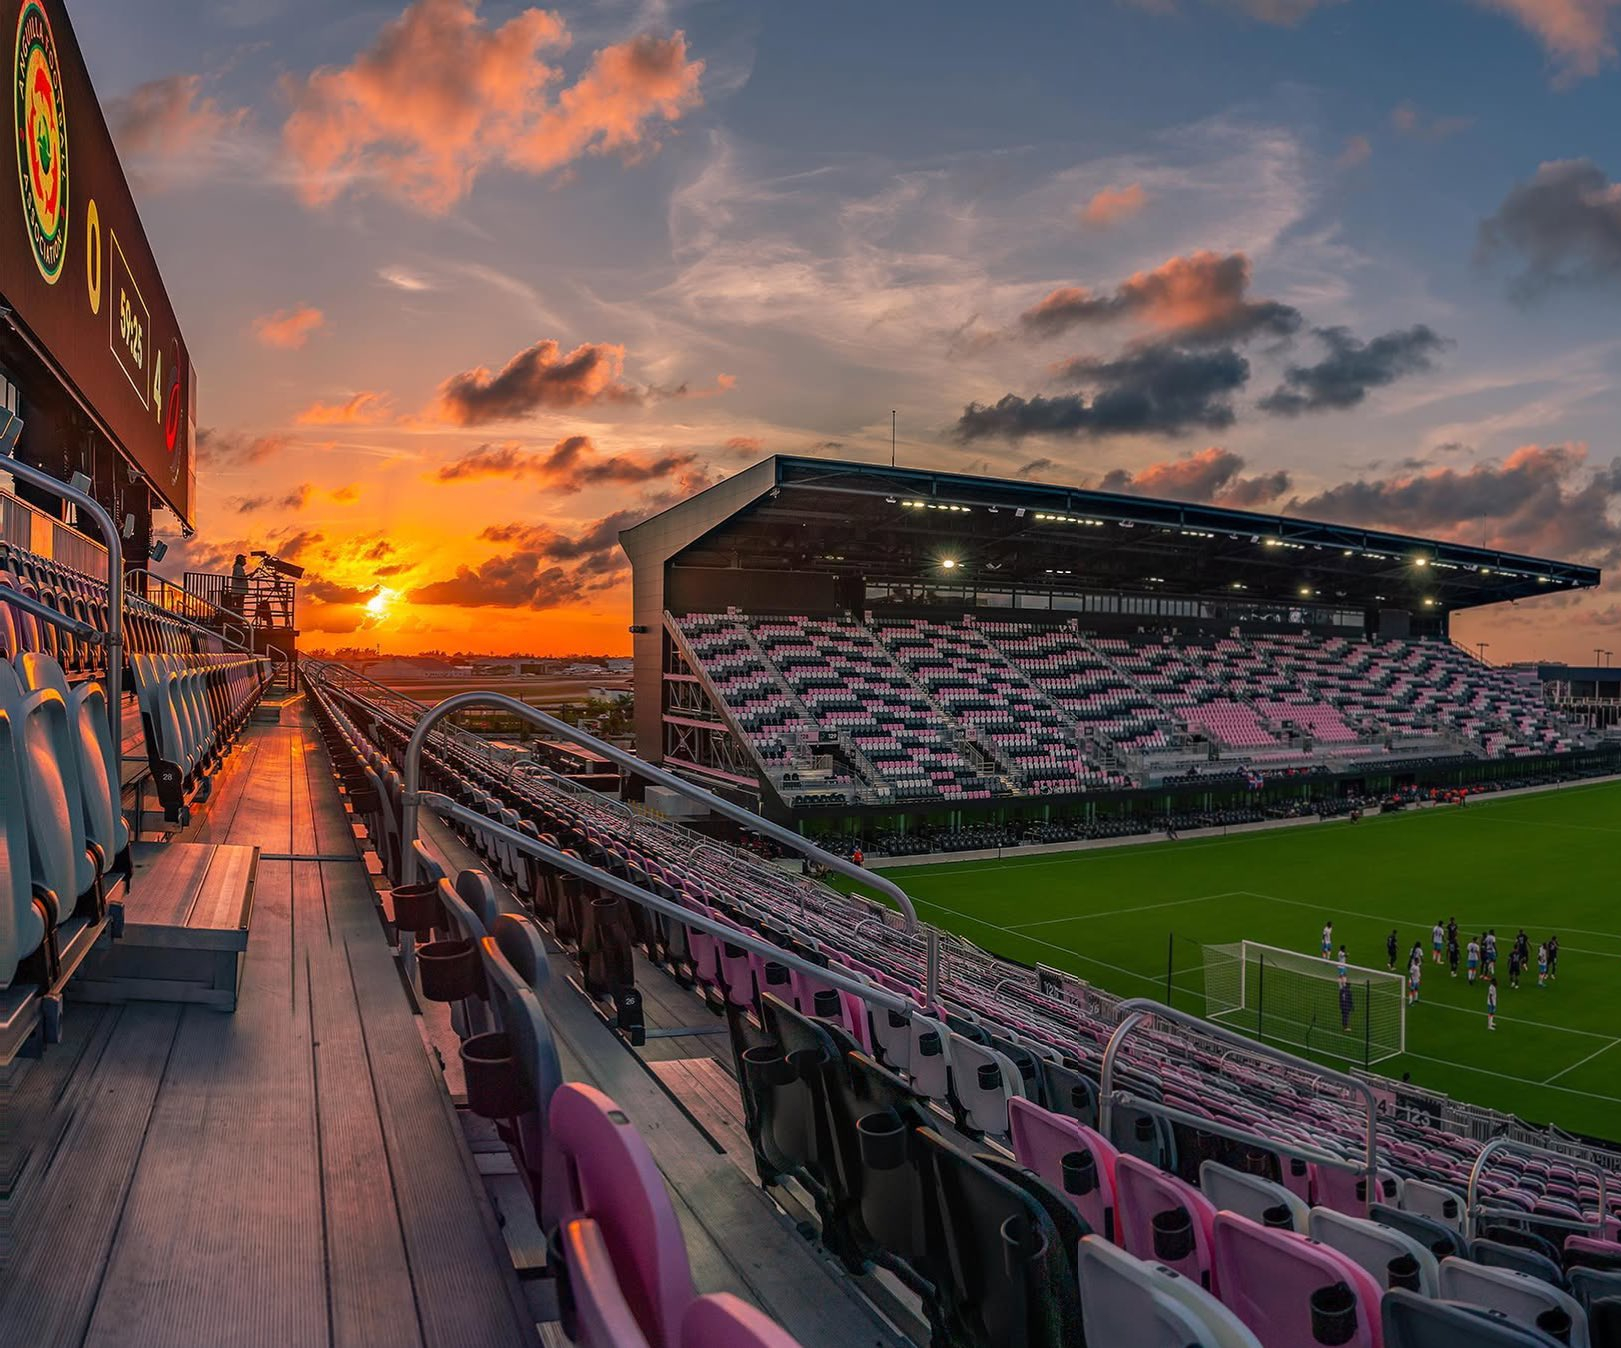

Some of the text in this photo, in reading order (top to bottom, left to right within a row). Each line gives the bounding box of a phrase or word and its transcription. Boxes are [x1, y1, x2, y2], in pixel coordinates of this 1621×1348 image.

[18, 16, 44, 100] ANGUILLA
[23, 173, 62, 264] ASSOCIATION
[119, 287, 143, 370] 59:25
[153, 350, 162, 425] 4
[162, 773, 173, 781] 28
[625, 997, 635, 1005] 26
